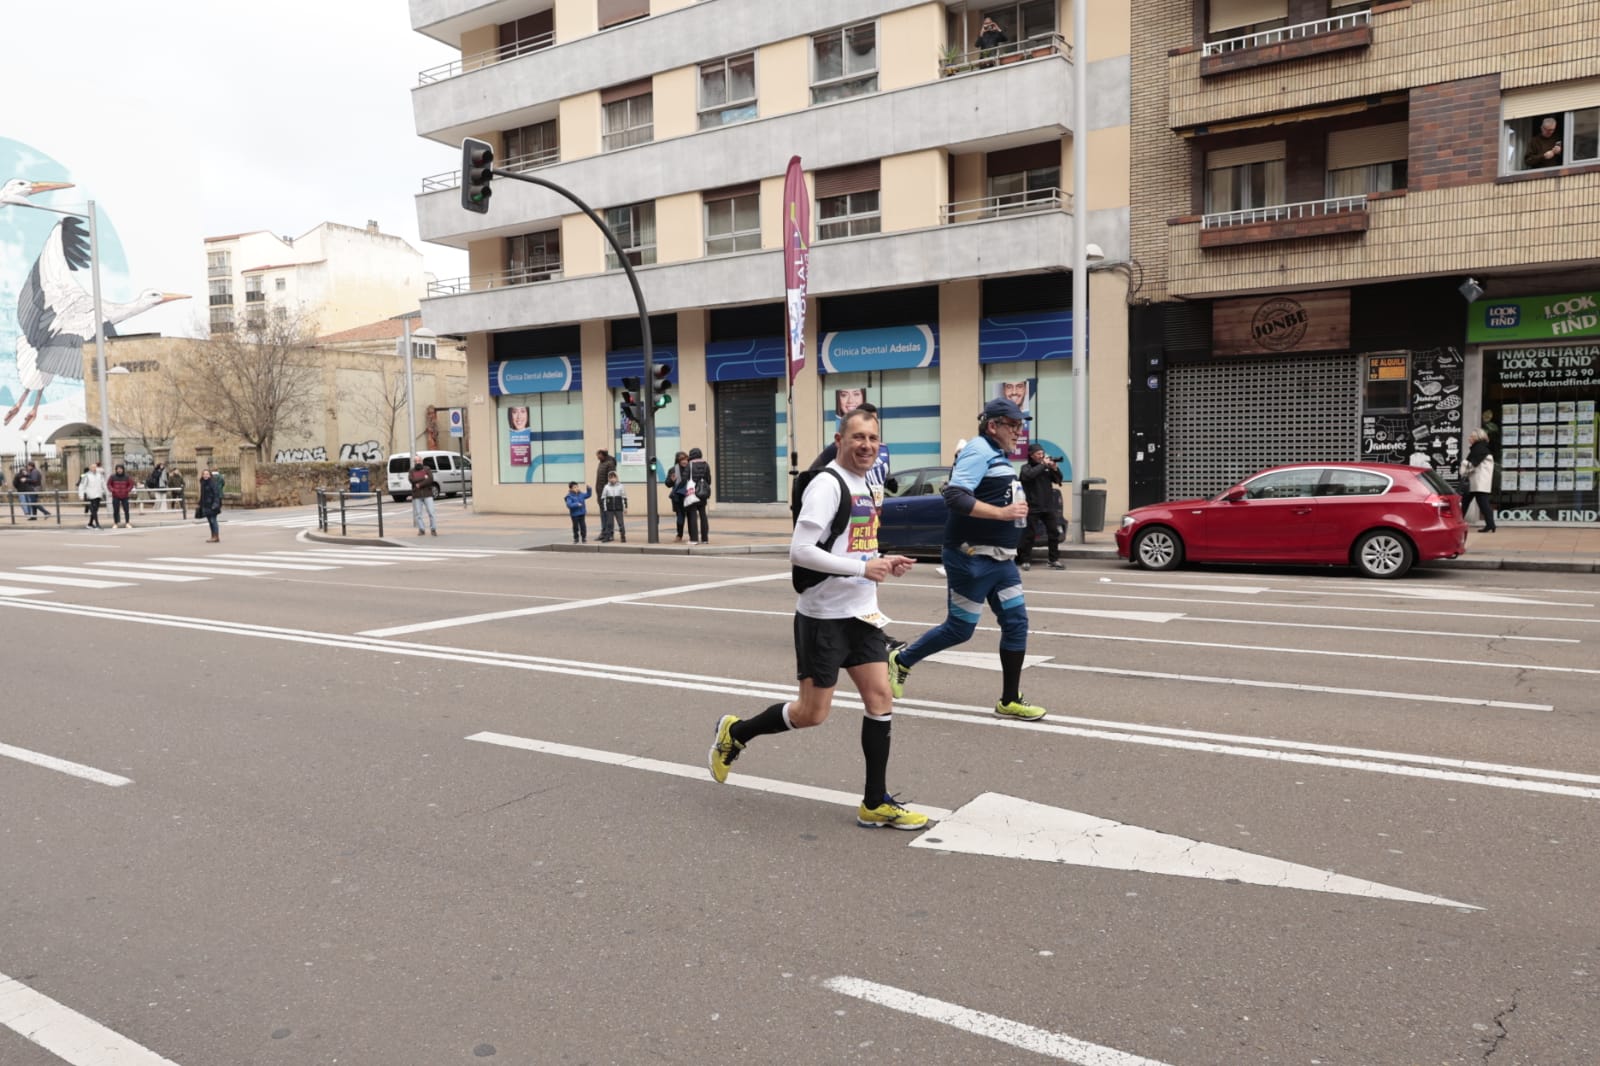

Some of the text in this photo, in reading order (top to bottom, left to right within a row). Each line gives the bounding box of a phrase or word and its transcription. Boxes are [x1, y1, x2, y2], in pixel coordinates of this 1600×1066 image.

[1489, 306, 1517, 316] LOOK
[1544, 295, 1597, 319] LOOK
[1252, 308, 1309, 339] JONBE
[1490, 317, 1515, 327] FIND
[1551, 314, 1598, 335] FIND
[861, 345, 888, 355] Dental
[889, 342, 921, 354] Adeslas
[1497, 346, 1600, 360] INMOBILIARIA
[1380, 358, 1406, 366] ALQUILA
[1502, 355, 1592, 370] LOOK & FIND
[523, 372, 541, 381] Dental
[1528, 370, 1547, 379] 923
[1550, 369, 1563, 378] 12
[1565, 369, 1579, 377] 36
[1581, 368, 1595, 377] 90
[1364, 438, 1407, 454] Jamones
[1492, 509, 1598, 522] LOOK & FIND
